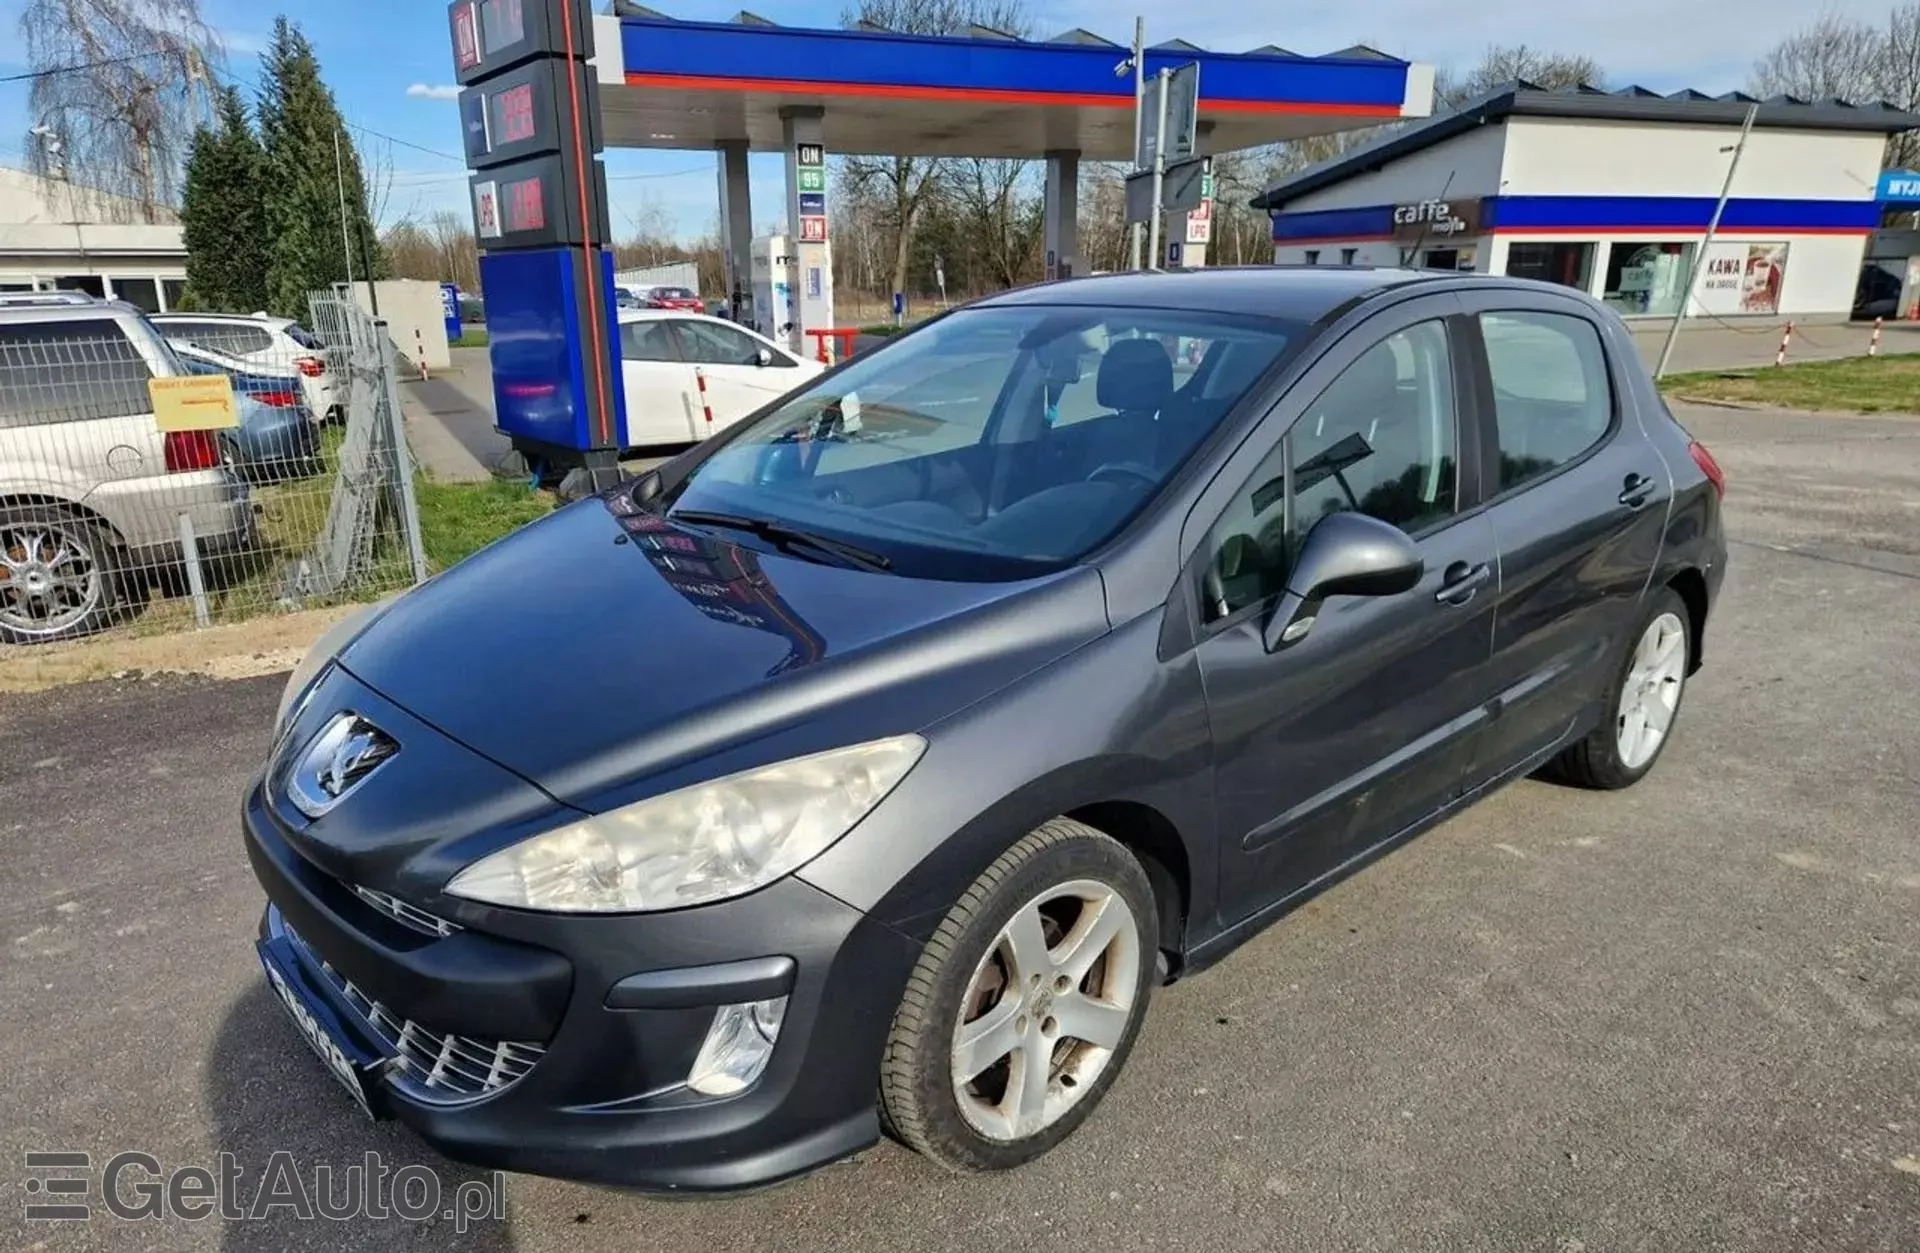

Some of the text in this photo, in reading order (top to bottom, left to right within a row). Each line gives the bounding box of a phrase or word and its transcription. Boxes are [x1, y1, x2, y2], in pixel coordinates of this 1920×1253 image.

[802, 147, 819, 163] ON
[803, 171, 820, 188] 95
[1190, 224, 1206, 239] LPG
[1707, 258, 1740, 275] KAWA
